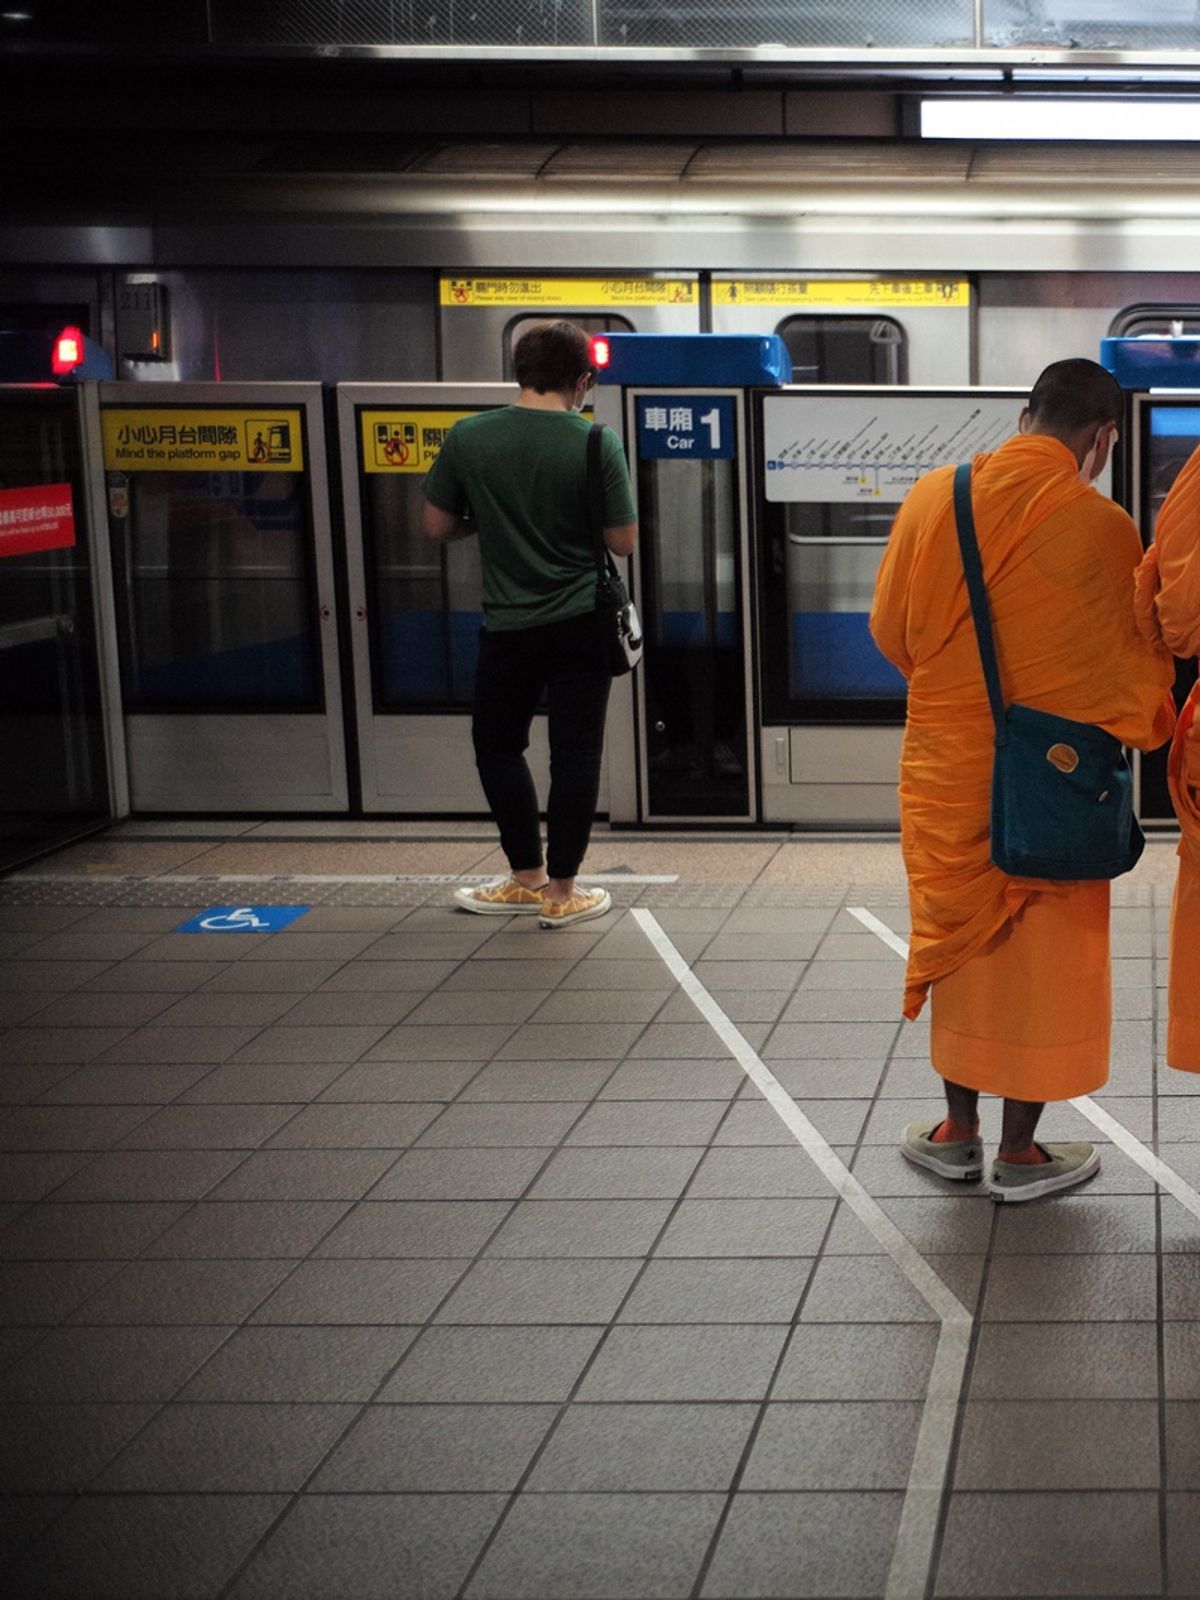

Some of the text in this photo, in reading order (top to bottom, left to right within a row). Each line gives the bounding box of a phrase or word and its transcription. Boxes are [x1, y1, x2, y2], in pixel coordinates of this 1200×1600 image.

[117, 424, 239, 446] 小心月台間隙
[644, 407, 721, 450] 車廂 1
[666, 435, 695, 450] Car
[115, 448, 241, 461] Mind the platform gap
